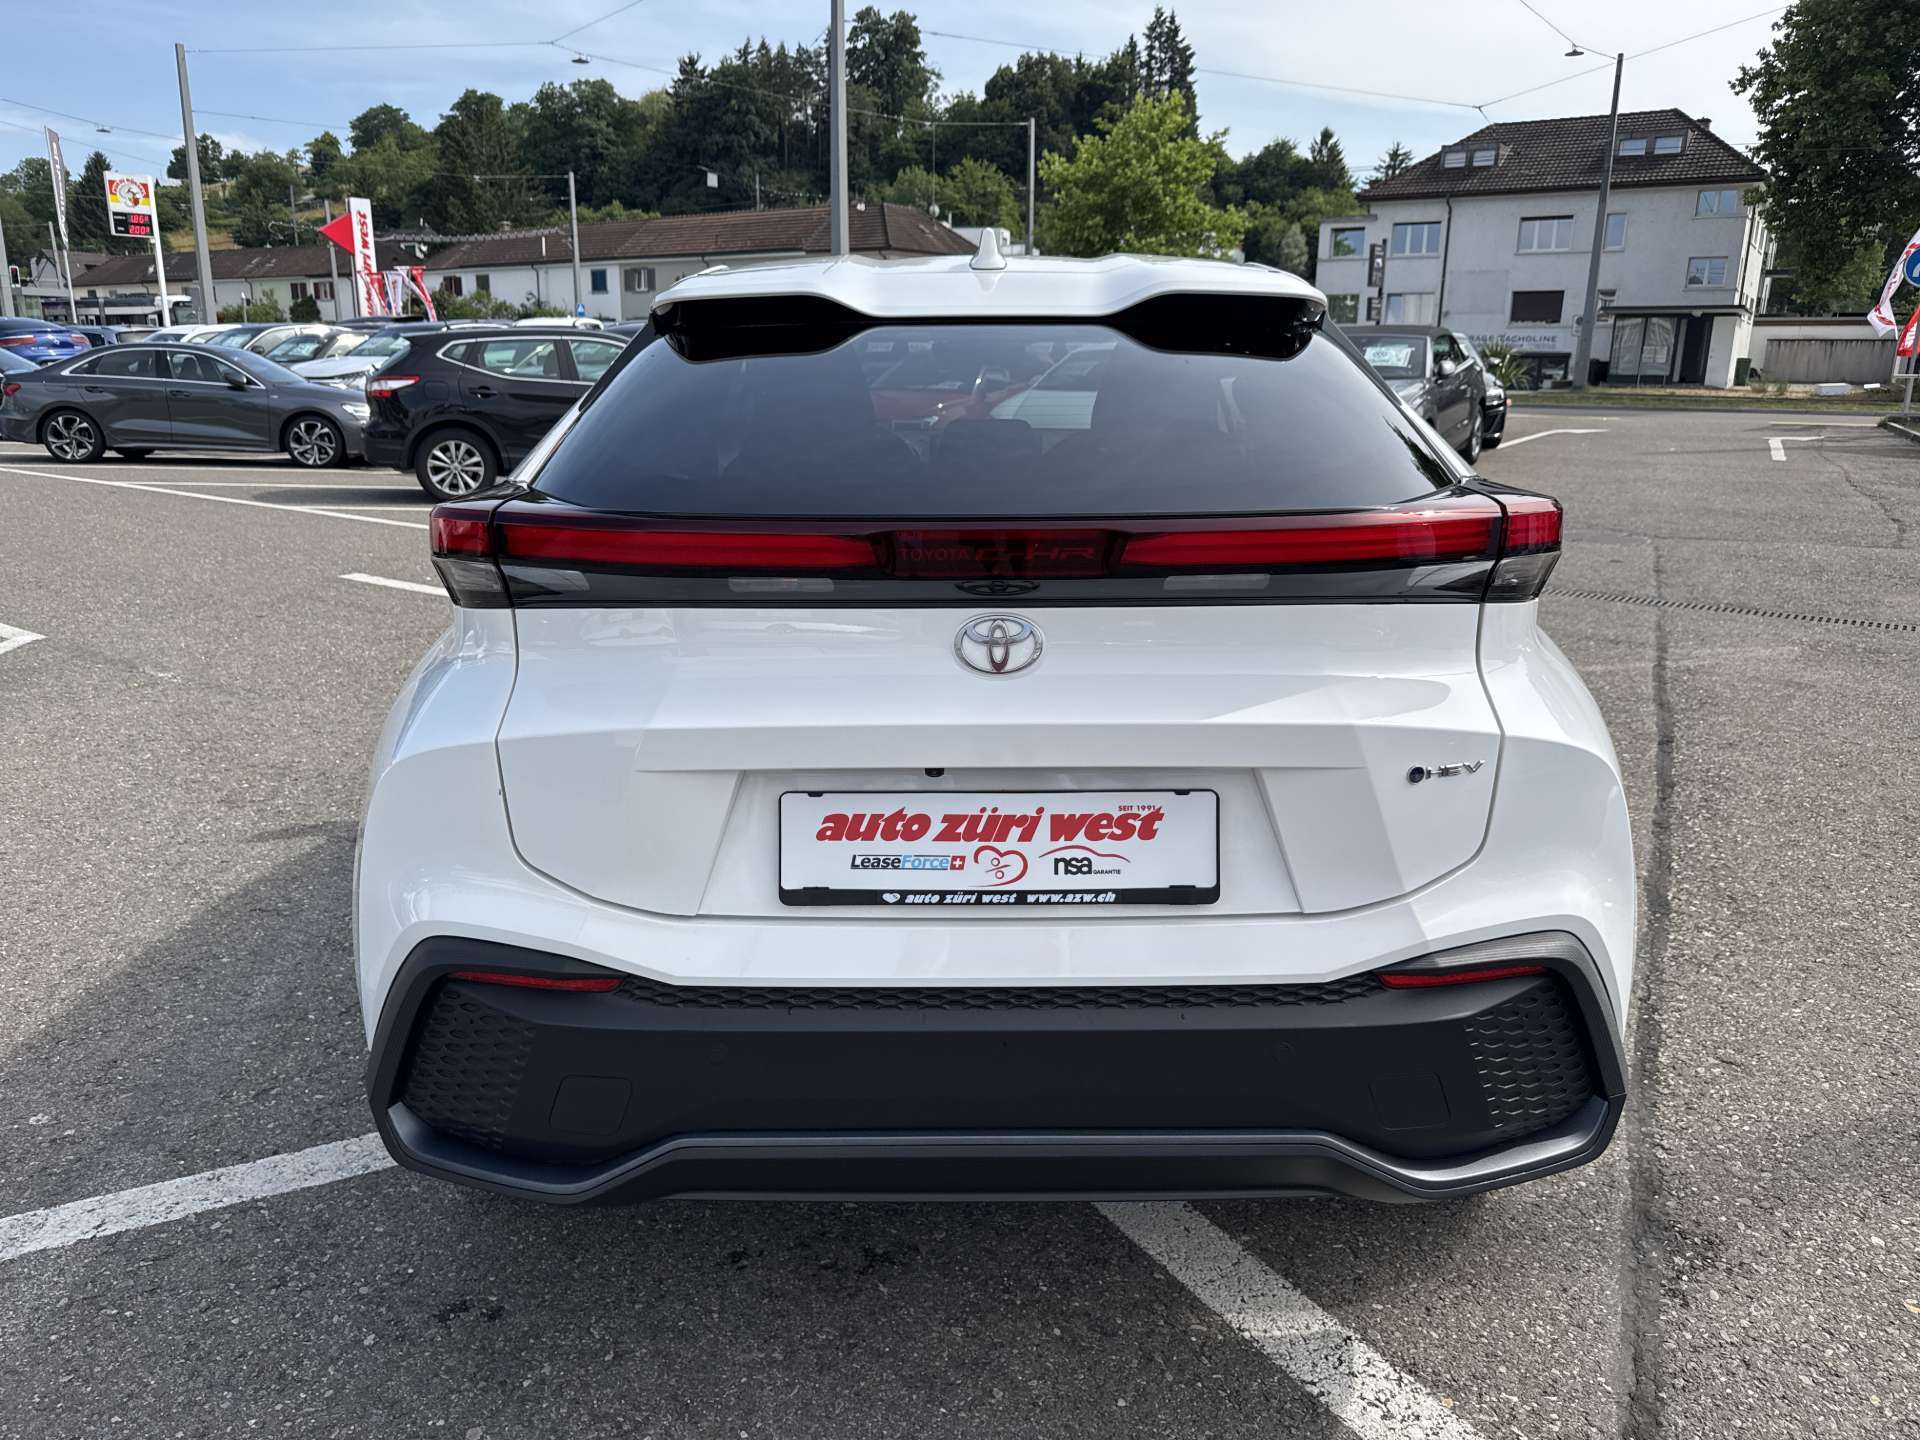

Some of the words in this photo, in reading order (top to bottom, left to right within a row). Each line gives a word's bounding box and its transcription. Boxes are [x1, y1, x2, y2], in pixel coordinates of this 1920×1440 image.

[901, 548, 969, 561] TOYOTA
[816, 807, 931, 842] auto
[932, 807, 1045, 842] züri
[1050, 806, 1165, 841] west
[851, 855, 949, 869] LeaseForce
[1054, 857, 1092, 875] nsa
[905, 894, 941, 904] auto
[943, 892, 978, 904] züri
[982, 893, 1017, 904] west
[1027, 892, 1116, 903] www.azw.ch
